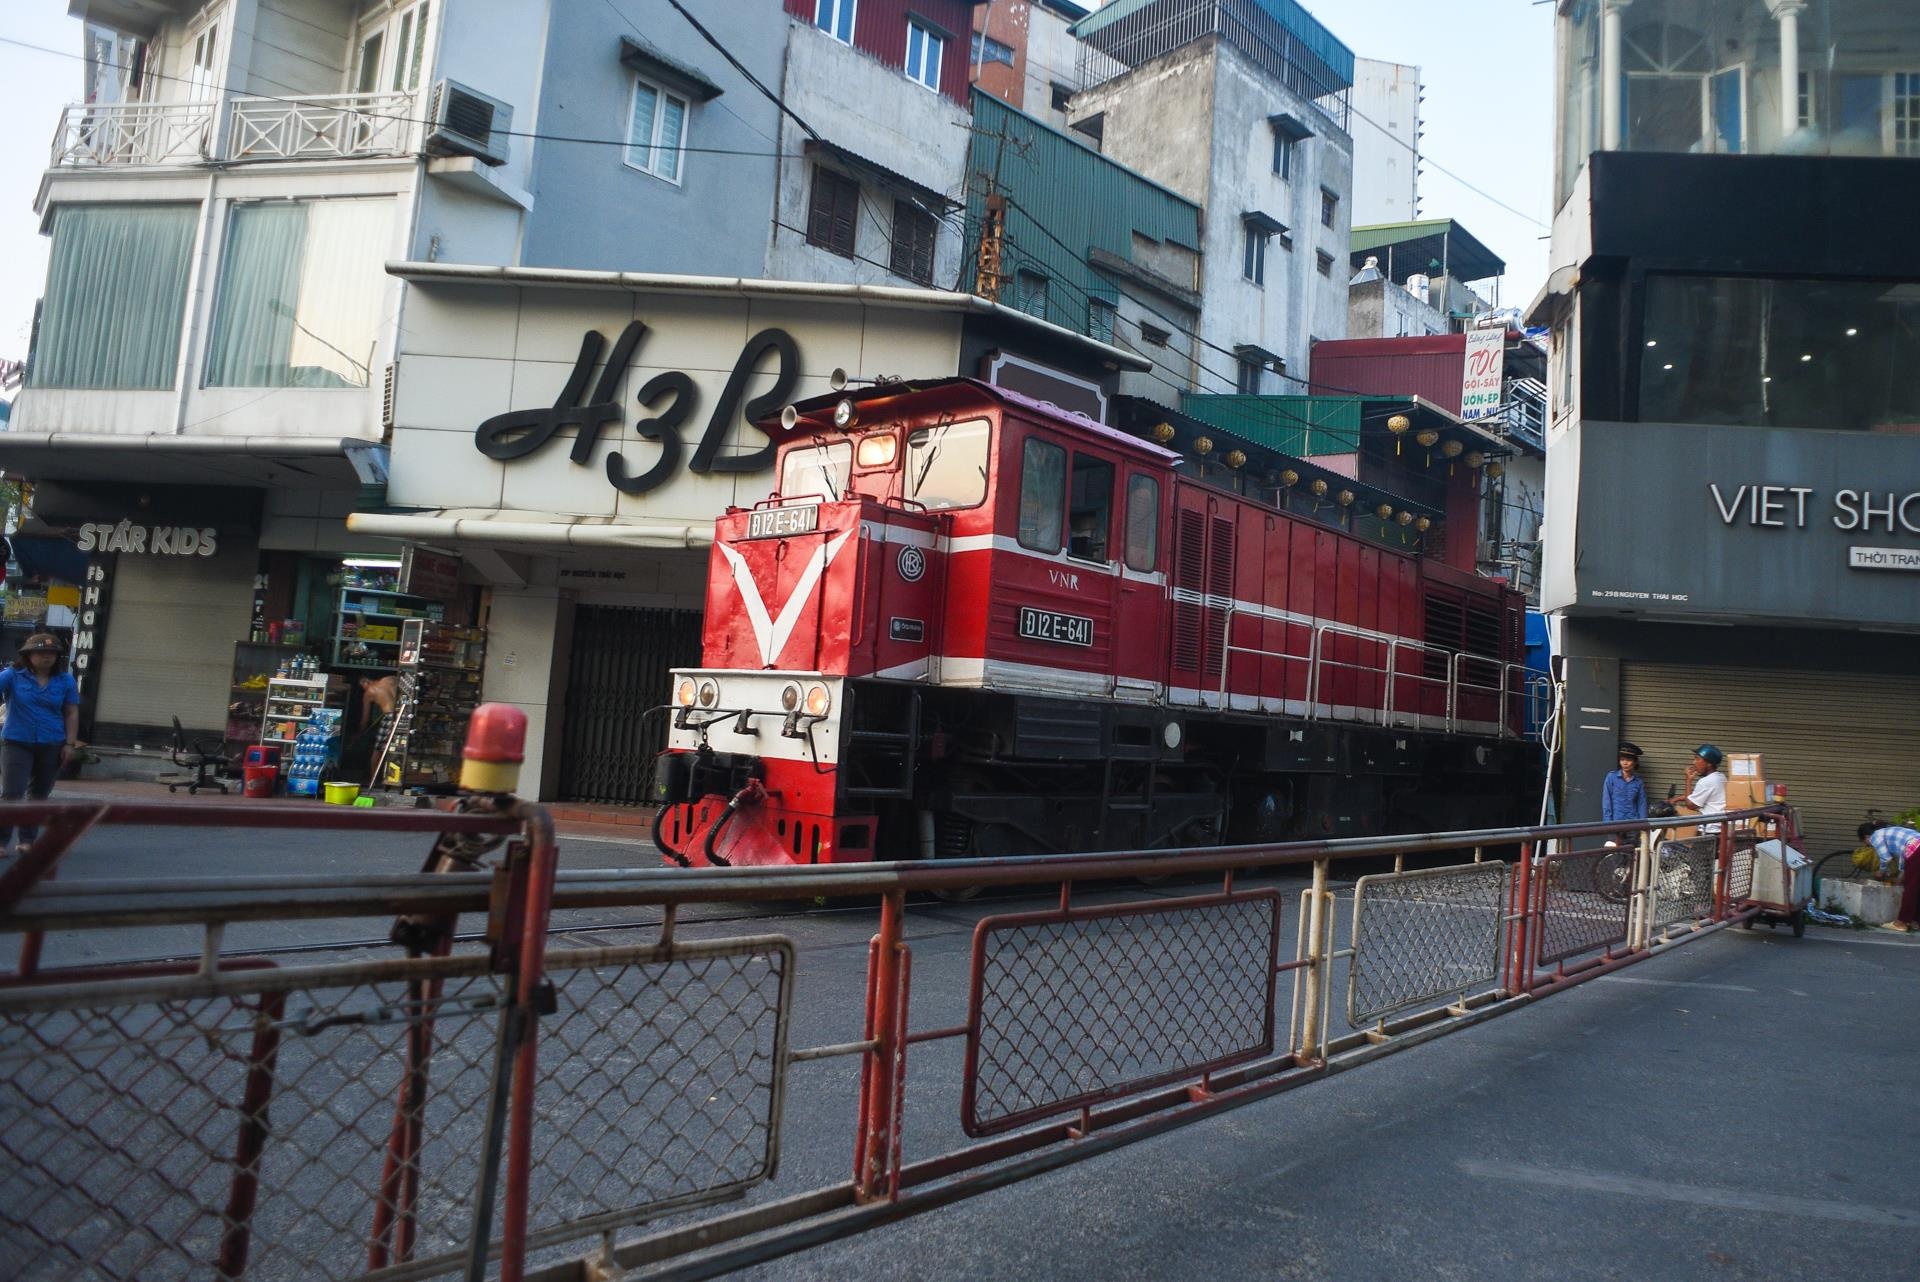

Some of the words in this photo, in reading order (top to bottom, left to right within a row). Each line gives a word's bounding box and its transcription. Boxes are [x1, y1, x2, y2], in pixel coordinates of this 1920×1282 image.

[1709, 483, 1813, 527] VIET
[77, 519, 147, 553] STAR
[150, 526, 217, 557] KIDS
[1855, 551, 1887, 563] THỜI
[1049, 569, 1079, 591] VNR
